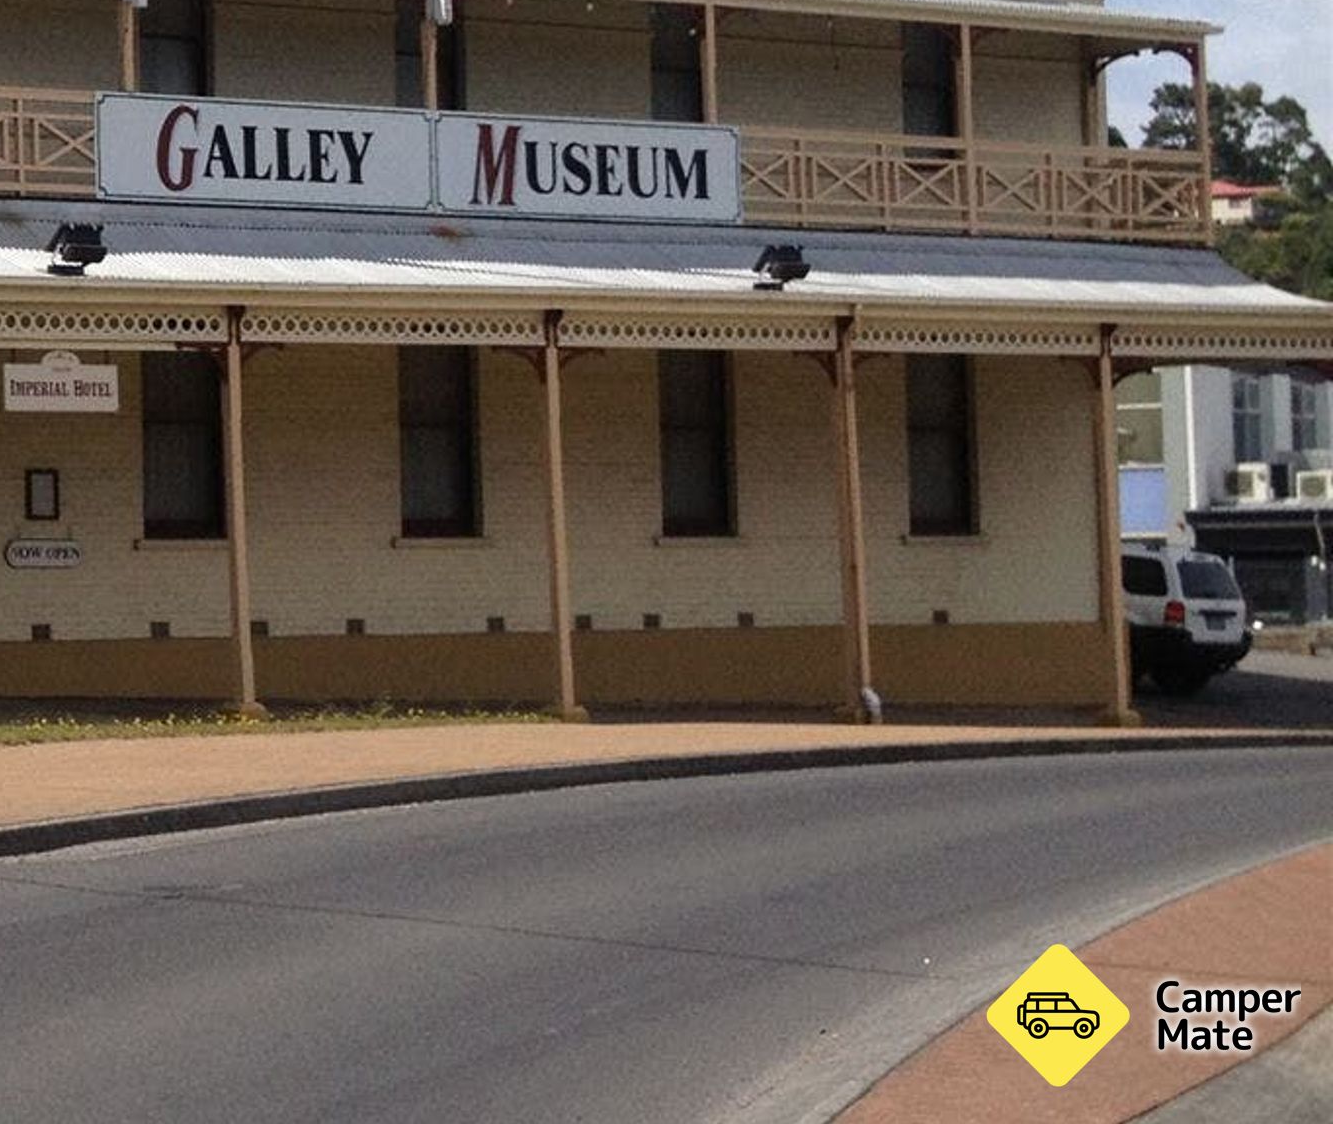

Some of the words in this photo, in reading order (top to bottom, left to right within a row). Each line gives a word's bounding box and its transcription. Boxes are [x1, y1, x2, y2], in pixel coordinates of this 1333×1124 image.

[156, 105, 374, 192] GALLEY
[469, 123, 710, 206] MUSEUM
[10, 379, 69, 397] IMPERIAL
[74, 379, 112, 397] HOTEL
